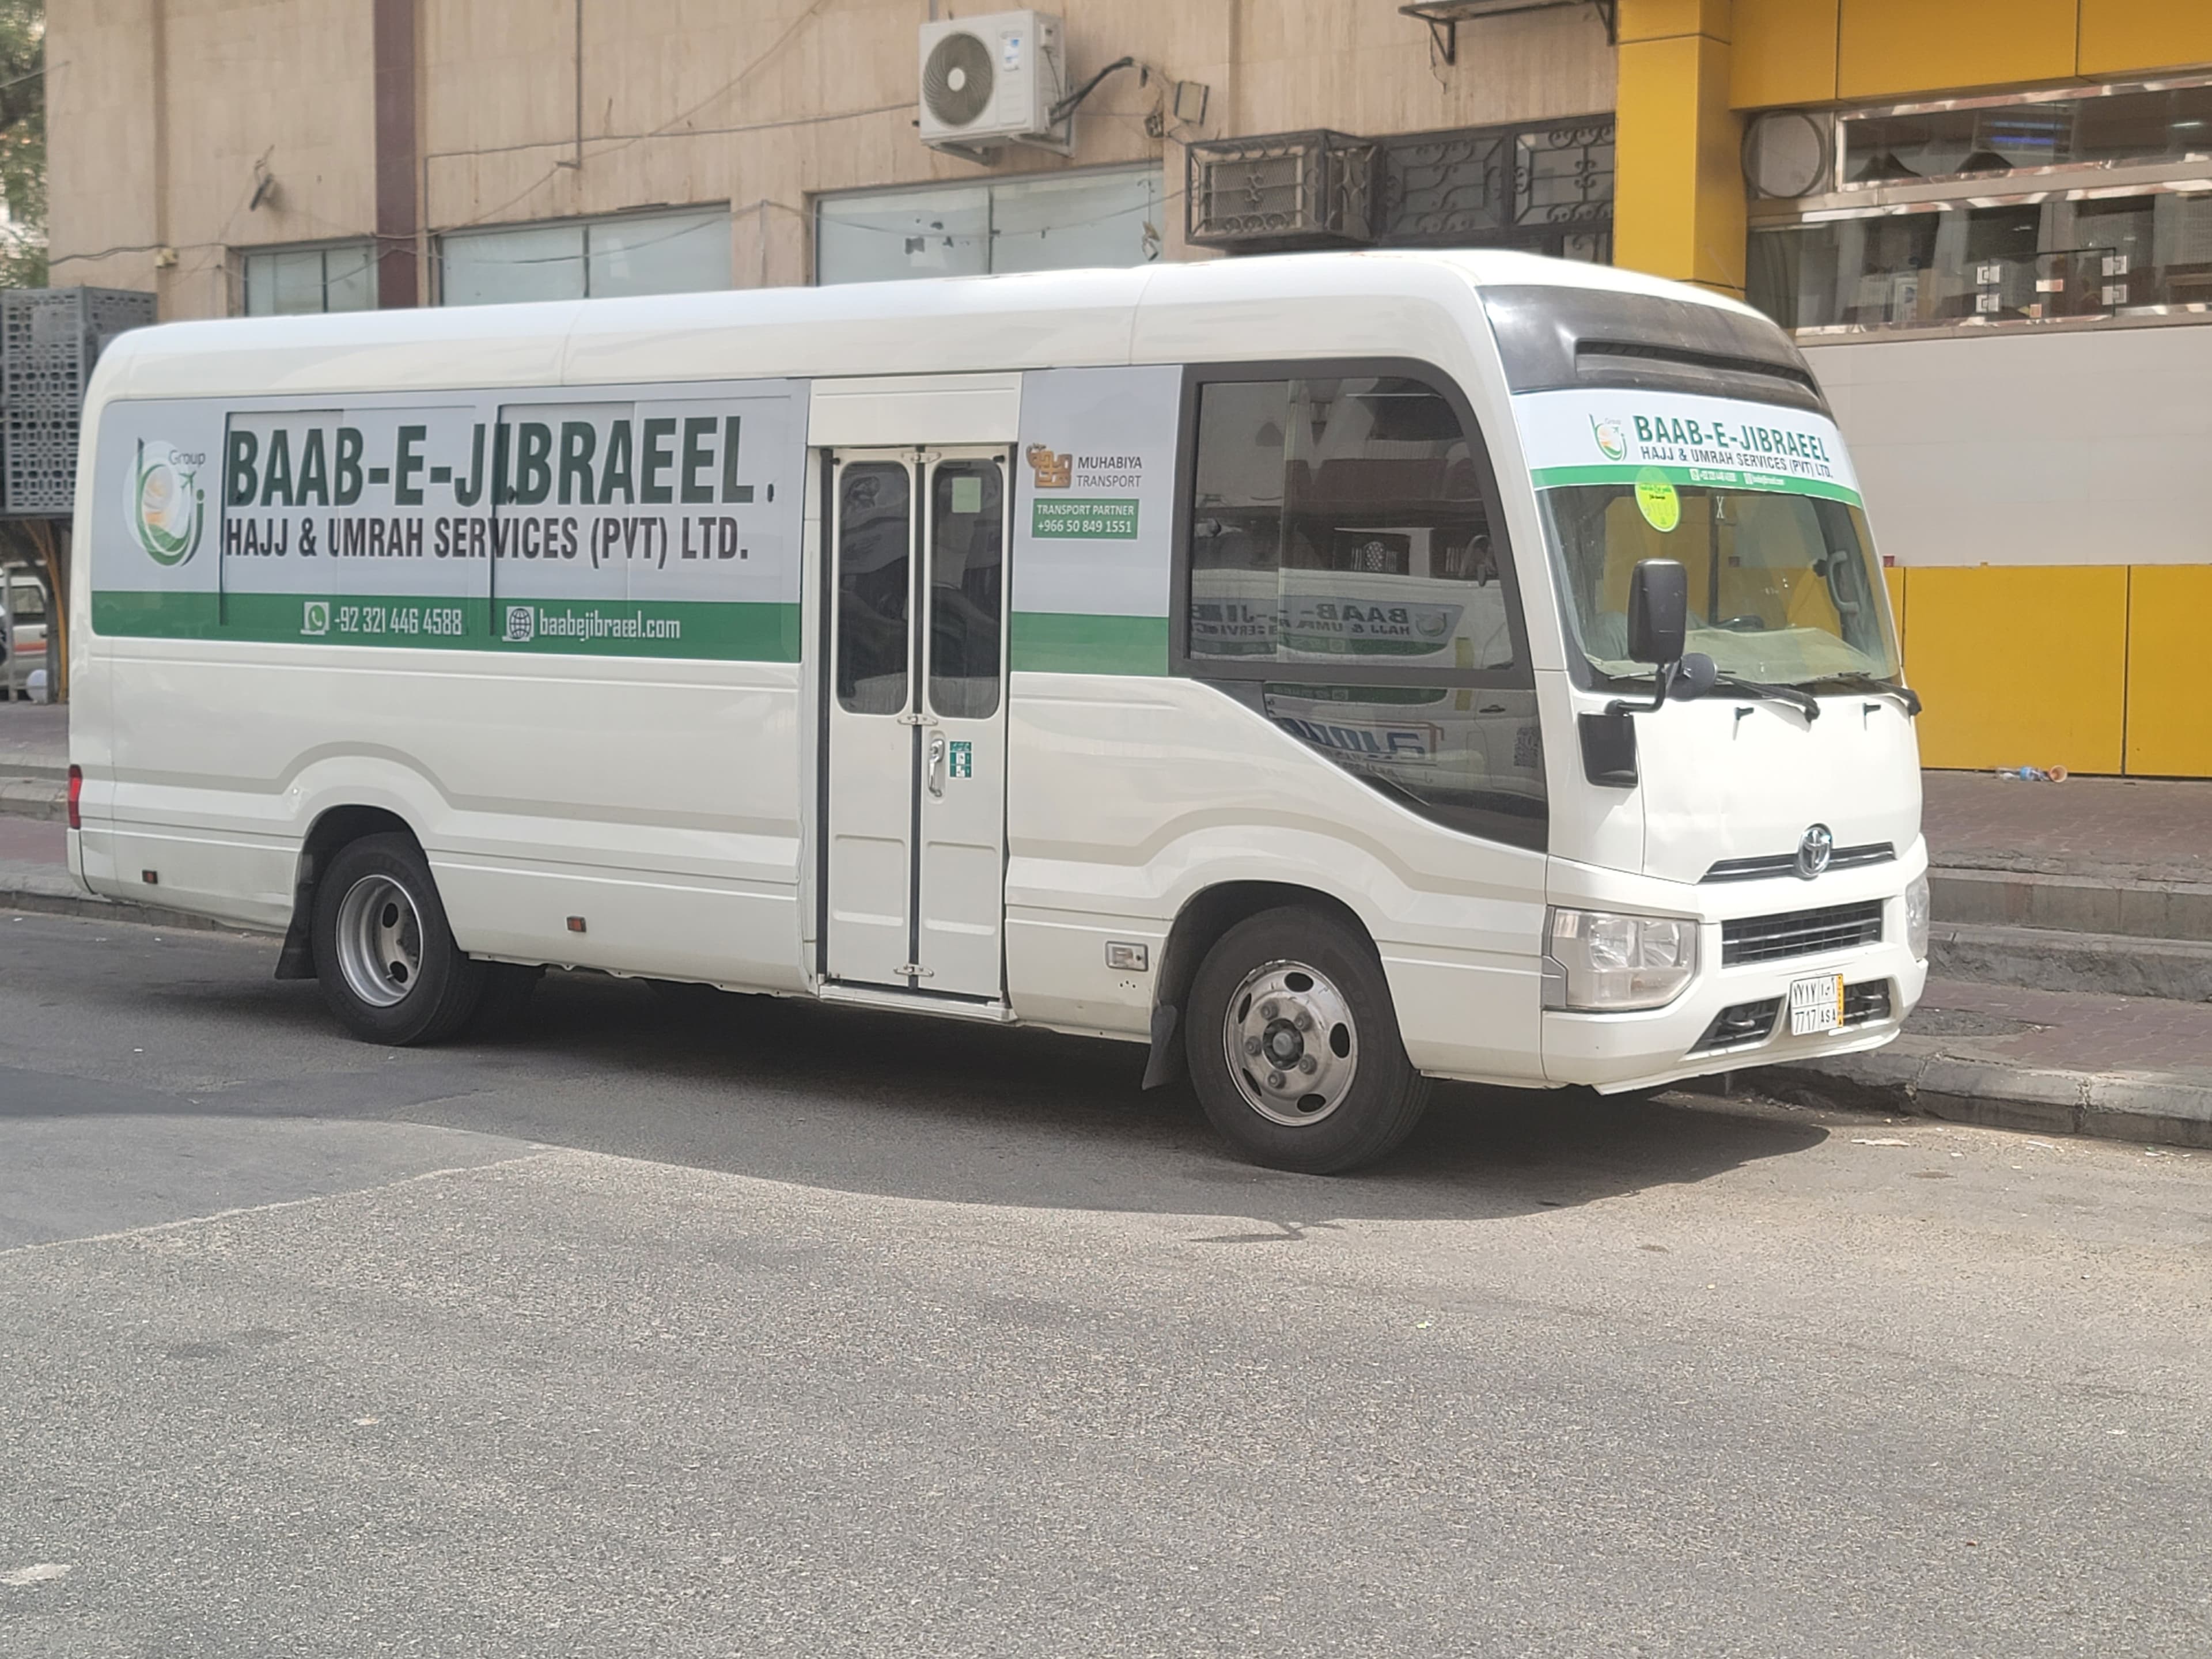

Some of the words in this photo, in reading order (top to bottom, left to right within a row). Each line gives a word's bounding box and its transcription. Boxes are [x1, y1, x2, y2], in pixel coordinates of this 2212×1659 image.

[1633, 415, 1830, 462] BAAB-E-JIBRAEEL
[169, 449, 206, 467] Group
[226, 416, 753, 507] BAAB-E-JIBRAEEL
[1078, 457, 1142, 468] MUHABIYA
[1641, 446, 1674, 460] HAJJ
[1678, 448, 1687, 461] &
[1691, 449, 1734, 464] UMRAH
[1736, 453, 1787, 470] SERVICES
[1790, 460, 1813, 476] (PVT)
[1816, 464, 1834, 478] LTD.
[1077, 475, 1141, 487] TRANSPORT
[1037, 505, 1090, 515] TRANSPORT
[1093, 505, 1134, 516] PARTNER
[1038, 520, 1063, 532] +966
[1066, 521, 1080, 532] 50
[1082, 521, 1103, 532] 849
[1105, 521, 1131, 532] 1551
[226, 518, 287, 557] HAJJ
[298, 517, 317, 557] &
[328, 518, 422, 557] UMRAH
[434, 517, 577, 559] SERVICES
[590, 517, 668, 569] (PVT)
[681, 517, 748, 559] LTD.
[363, 607, 385, 632] 321
[390, 608, 418, 634] 446
[423, 608, 461, 635] 4588
[1795, 1009, 1816, 1033] 7717
